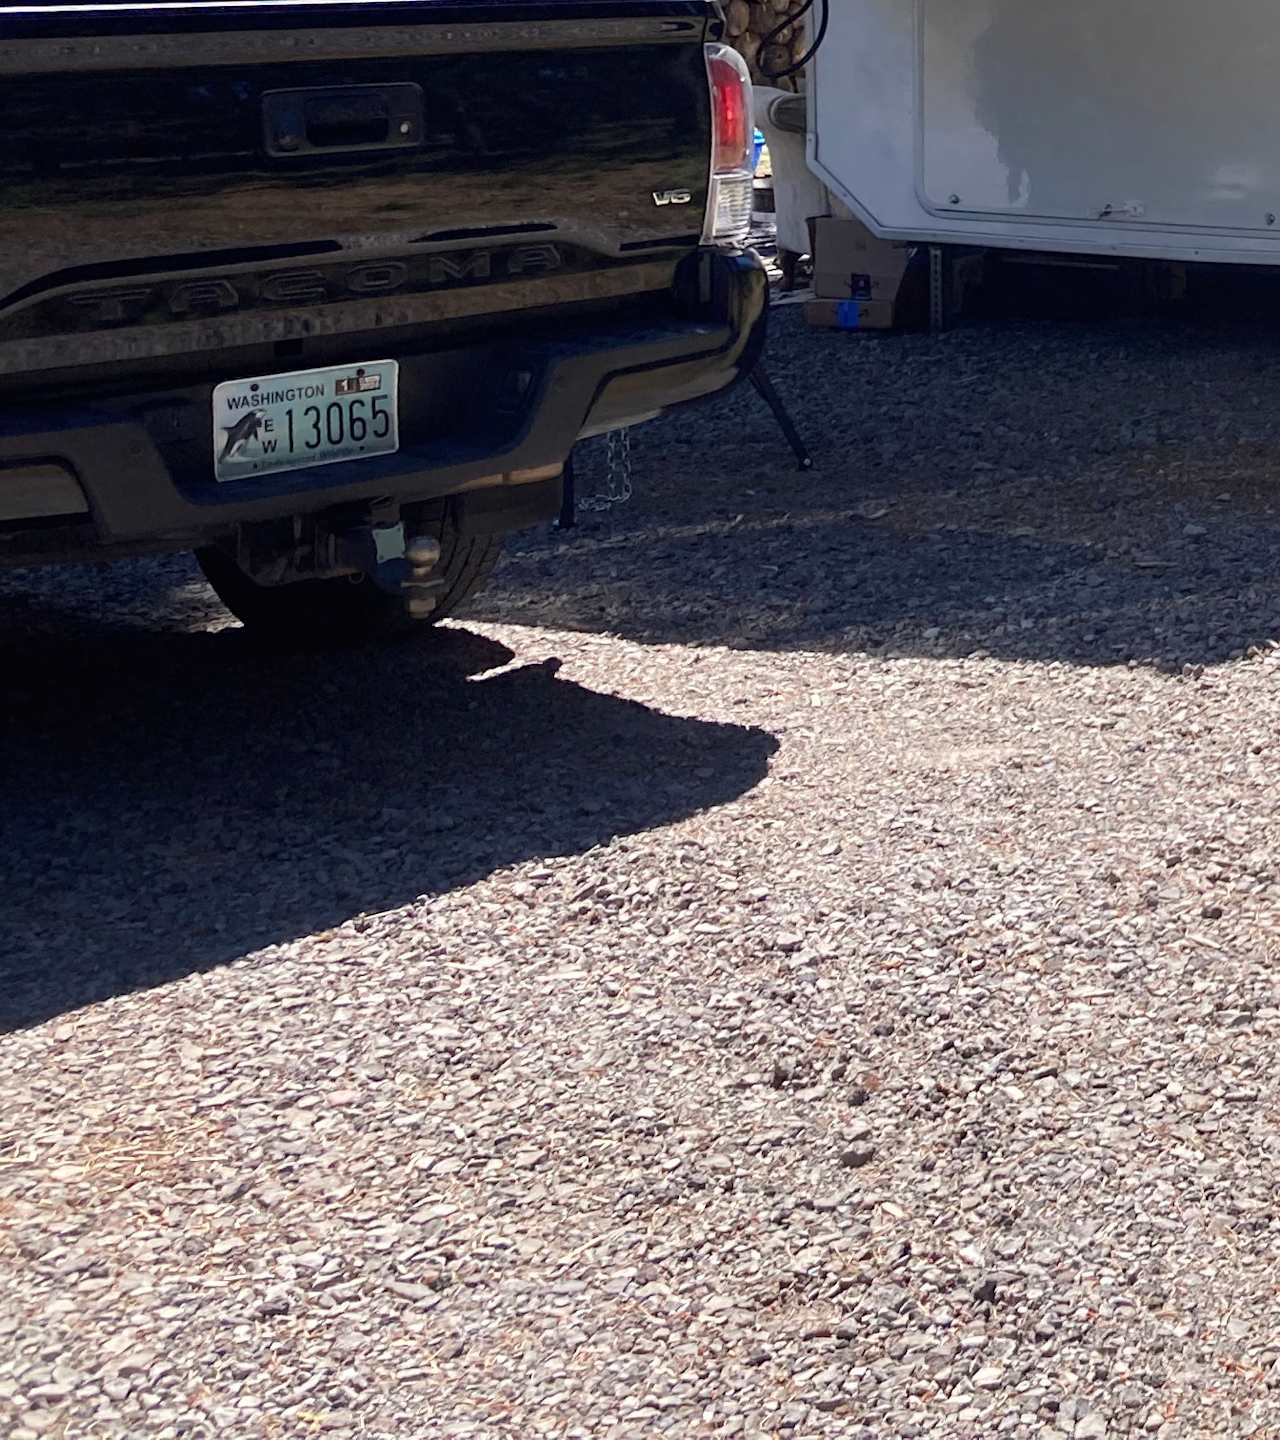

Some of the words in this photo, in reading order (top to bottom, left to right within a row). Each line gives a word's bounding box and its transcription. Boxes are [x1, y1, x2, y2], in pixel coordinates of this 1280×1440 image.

[66, 243, 565, 318] TACOMA
[227, 384, 325, 410] WASHINGTON
[285, 394, 389, 453] 13065
